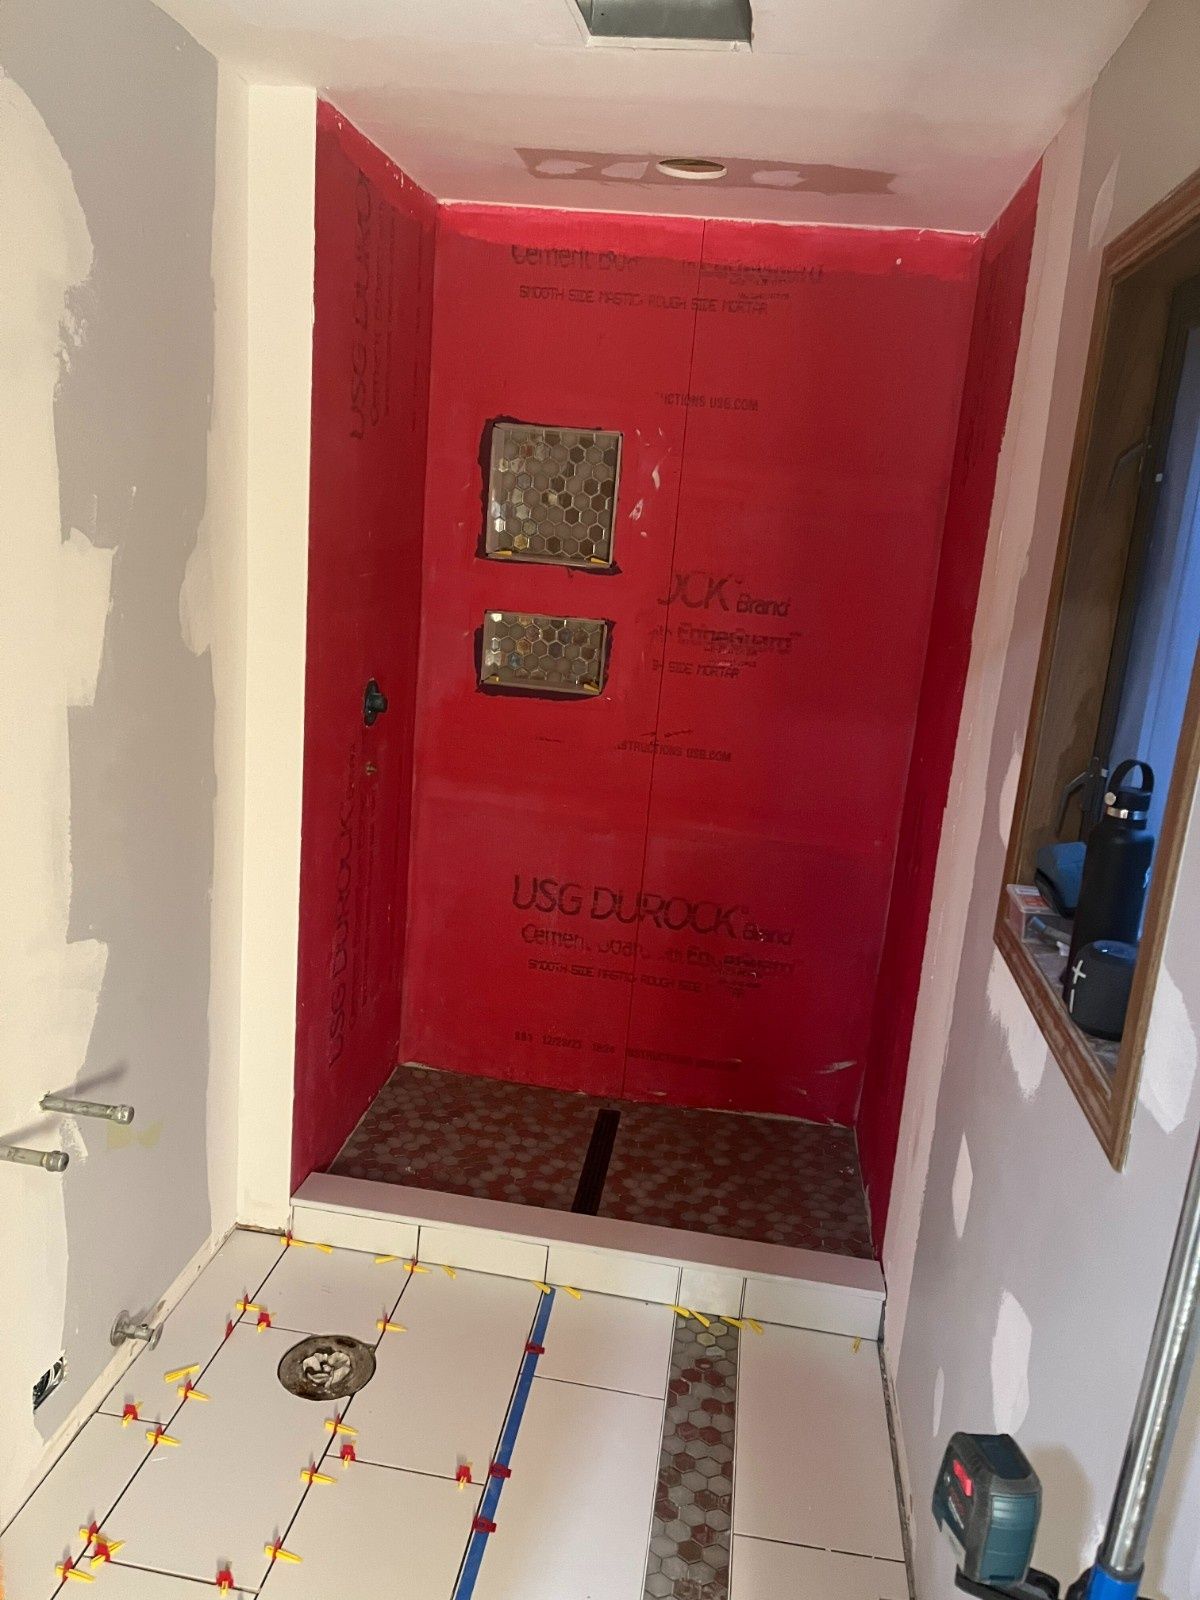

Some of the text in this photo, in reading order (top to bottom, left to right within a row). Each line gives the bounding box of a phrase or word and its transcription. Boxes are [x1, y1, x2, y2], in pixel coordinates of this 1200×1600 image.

[519, 285, 564, 300] SMOOTH
[568, 289, 594, 303] SIDE
[648, 294, 686, 310] ROUGH
[691, 297, 717, 312] SIDE
[721, 299, 767, 314] MORTAR
[736, 592, 792, 617] Brand
[668, 660, 693, 674] SIDE
[696, 664, 740, 679] MORTAR
[512, 874, 583, 915] USG
[590, 885, 738, 939] DUROCK
[528, 959, 568, 974] SMOOTH
[570, 964, 595, 978] SIDE
